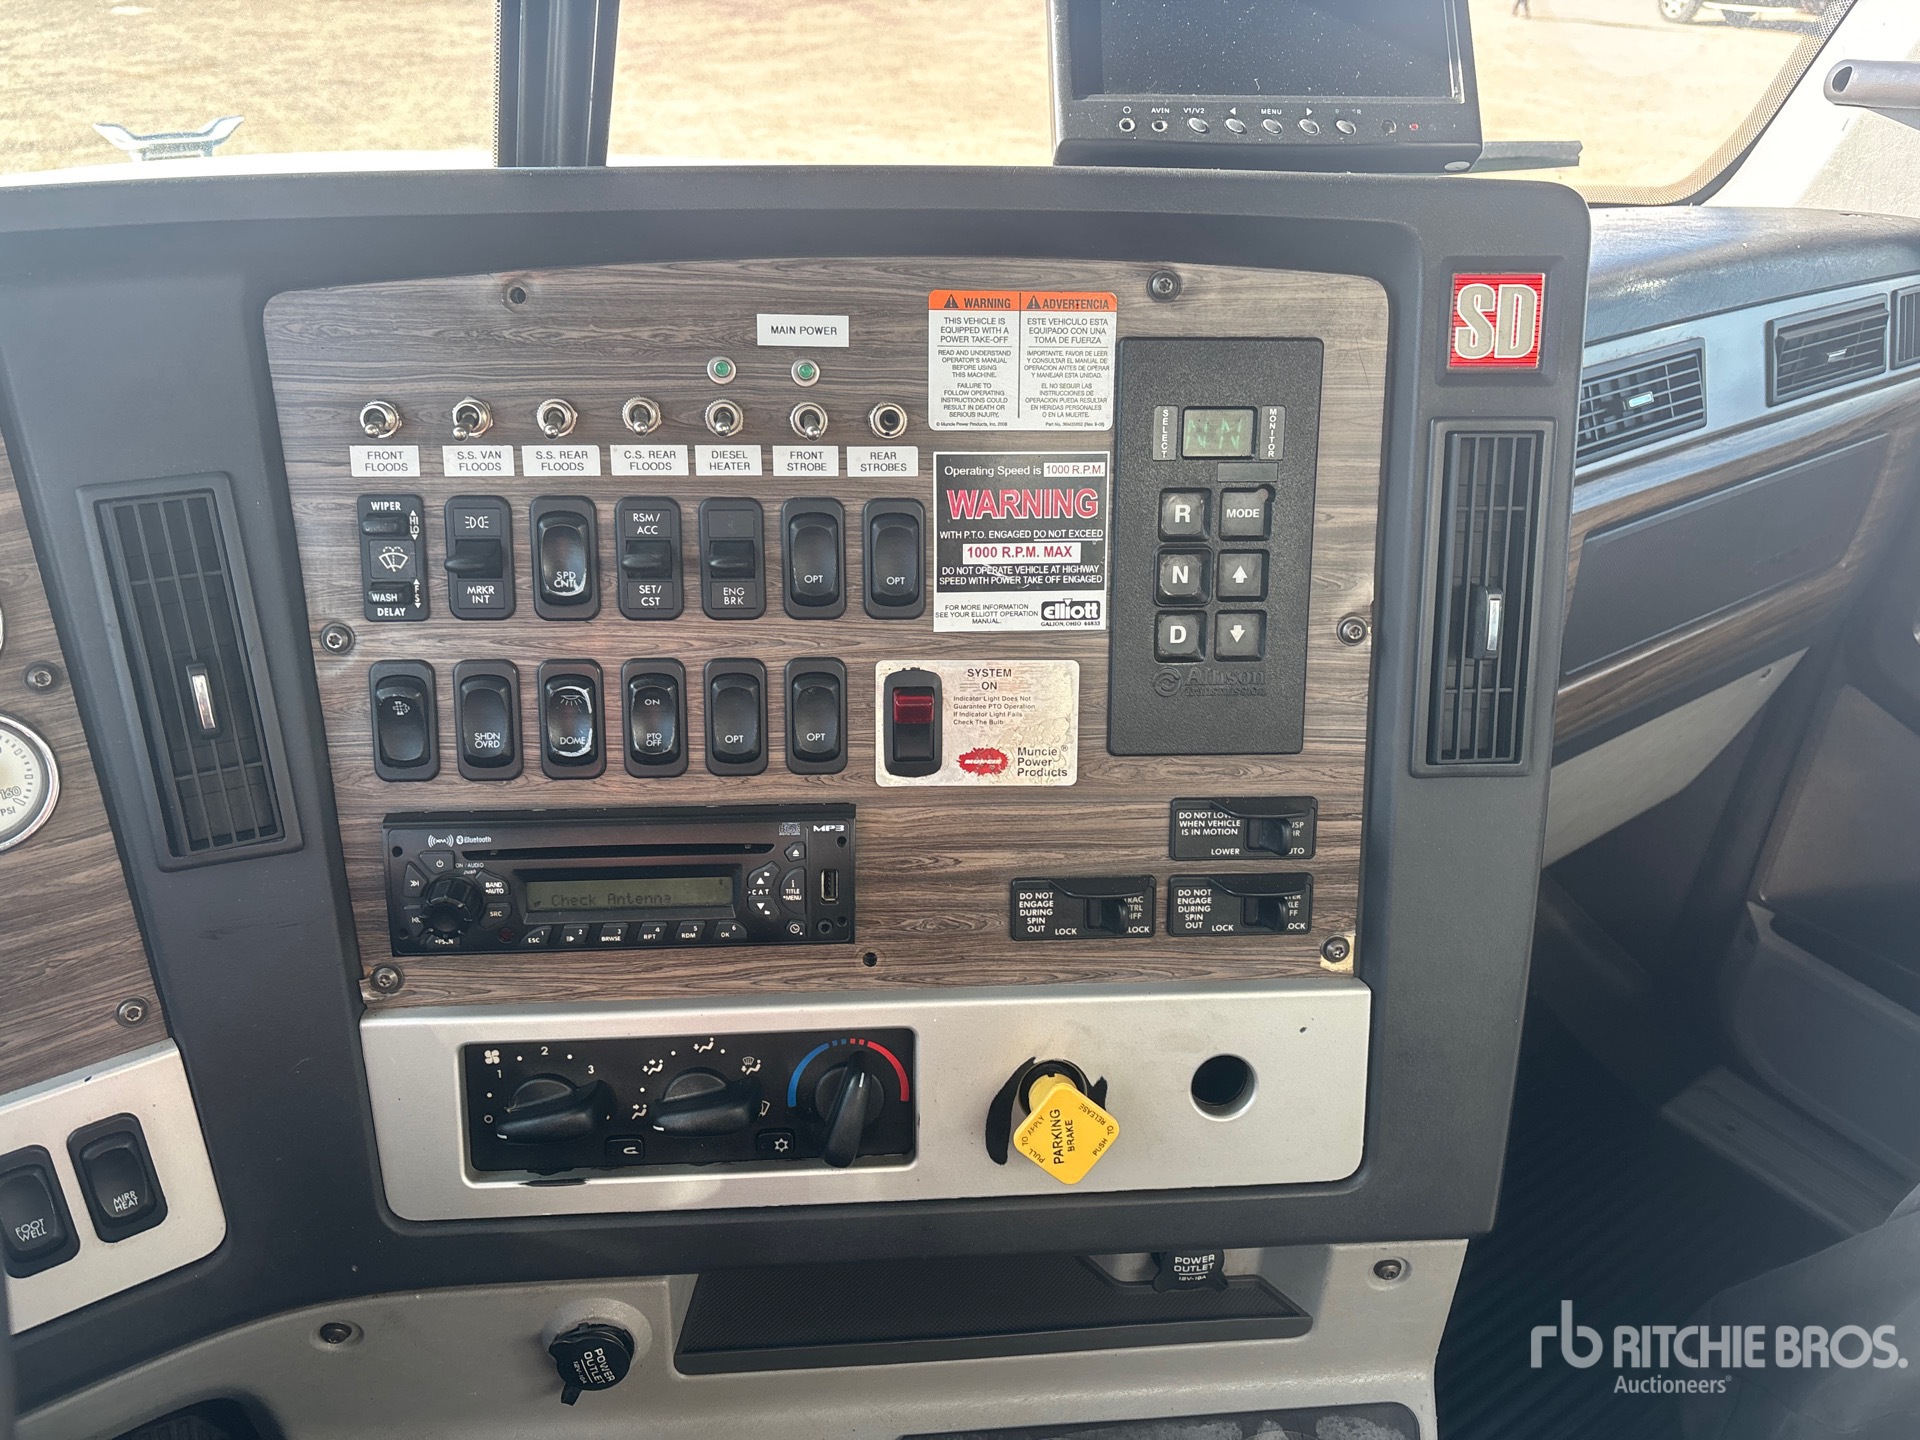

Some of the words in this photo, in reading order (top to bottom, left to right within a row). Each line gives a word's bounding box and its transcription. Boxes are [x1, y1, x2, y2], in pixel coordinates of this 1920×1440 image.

[1183, 107, 1205, 115] V1/V2
[1261, 108, 1282, 116] MENU
[964, 298, 1011, 309] WARNING
[1042, 299, 1109, 310] ADVERTENCIA
[1049, 318, 1087, 326] VEHICULO
[1455, 283, 1537, 359] SD
[771, 326, 796, 335] MAIN
[800, 326, 837, 335] POWER
[941, 326, 979, 334] EQUIPPED
[1029, 327, 1068, 335] EQUIPADO
[1268, 409, 1277, 458] MONITOR
[367, 451, 403, 460] FRONT
[457, 451, 478, 460] S.S.
[481, 451, 501, 460] VAN
[535, 451, 557, 459] S.S.
[559, 451, 588, 459] REAR
[624, 451, 645, 459] C.S.
[649, 451, 676, 459] REAR
[711, 451, 747, 459] DIESEL
[790, 451, 824, 460] FRONT
[870, 452, 897, 460] REAR
[365, 463, 408, 472] FLOODS
[459, 462, 502, 471] FLOODS
[541, 462, 584, 471] FLOODS
[630, 462, 672, 470] FLOODS
[709, 462, 750, 470] HEATER
[787, 463, 827, 471] STROBE
[860, 463, 907, 472] STROBES
[945, 466, 994, 477] Operating
[997, 465, 1030, 476] Speed
[1033, 466, 1041, 474] is
[1047, 465, 1070, 474] 1000
[1072, 465, 1103, 474] R.P.M.
[371, 502, 401, 511] WIPER
[947, 488, 1098, 519] WARNING
[633, 513, 660, 522] RSM/
[1175, 505, 1190, 522] R
[1226, 509, 1259, 518] MODE
[410, 516, 419, 525] HI
[410, 525, 419, 534] LO
[637, 526, 658, 535] ACC
[940, 531, 962, 539] WITH
[964, 531, 986, 539] P.T.O.
[989, 530, 1031, 539] ENGAGED
[1034, 530, 1046, 538] DO
[1049, 530, 1066, 538] NOT
[1069, 529, 1103, 538] EXCEED
[967, 547, 997, 558] 1000
[1002, 546, 1039, 557] R.P.M.
[1044, 546, 1072, 557] MAX
[942, 567, 954, 575] DO
[956, 567, 973, 575] NOT
[975, 566, 1013, 575] OPERATE
[1015, 566, 1048, 574] VEHICLE
[1050, 565, 1061, 573] AT
[1062, 565, 1099, 573] HIGHWAY
[1172, 566, 1188, 583] N
[556, 572, 576, 580] SPD
[804, 575, 823, 584] OPT
[939, 577, 966, 585] SPEED
[969, 577, 989, 585] WITH
[991, 576, 1021, 584] POWER
[1023, 576, 1043, 584] TAKE
[1045, 576, 1061, 584] OFF
[1063, 575, 1102, 583] ENGAGED
[886, 577, 905, 585] OPT
[467, 586, 495, 595] MRKR
[639, 584, 662, 594] SET/
[723, 588, 744, 596] ENG
[372, 594, 397, 602] WASH
[472, 595, 490, 604] INT
[641, 597, 660, 606] CST
[724, 596, 744, 605] BRK
[377, 608, 406, 616] DELAY
[1170, 626, 1186, 643] D
[967, 669, 1011, 677] SYSTEM
[981, 682, 998, 690] ON
[475, 732, 500, 740] SHDN
[560, 736, 586, 745] DOME
[725, 735, 744, 743] OPT
[806, 733, 825, 741] OPT
[475, 740, 500, 748] OVRD
[1017, 758, 1052, 766] Power
[1017, 768, 1067, 777] Products
[1179, 820, 1205, 828] WHEN
[551, 894, 596, 906] Check
[607, 892, 672, 905] Antenna
[541, 1046, 548, 1056] 2
[588, 1065, 594, 1074] 3
[1079, 1103, 1106, 1125] RELEASE
[1028, 1116, 1045, 1135] APPLY
[1107, 1126, 1114, 1135] TO
[1050, 1109, 1064, 1164] PARKING
[1065, 1120, 1075, 1152] BRAKE
[1022, 1136, 1028, 1146] TO
[1093, 1139, 1108, 1156] PUSH
[1029, 1148, 1045, 1163] PULL
[113, 1191, 135, 1204] MIRR
[114, 1197, 139, 1213] HEAT
[15, 1219, 44, 1234] FOOT
[18, 1228, 47, 1242] WELL
[1175, 1254, 1214, 1264] POWER
[1174, 1263, 1214, 1272] OUTLET
[584, 1351, 605, 1384] OUTLET
[594, 1348, 615, 1381] POWER
